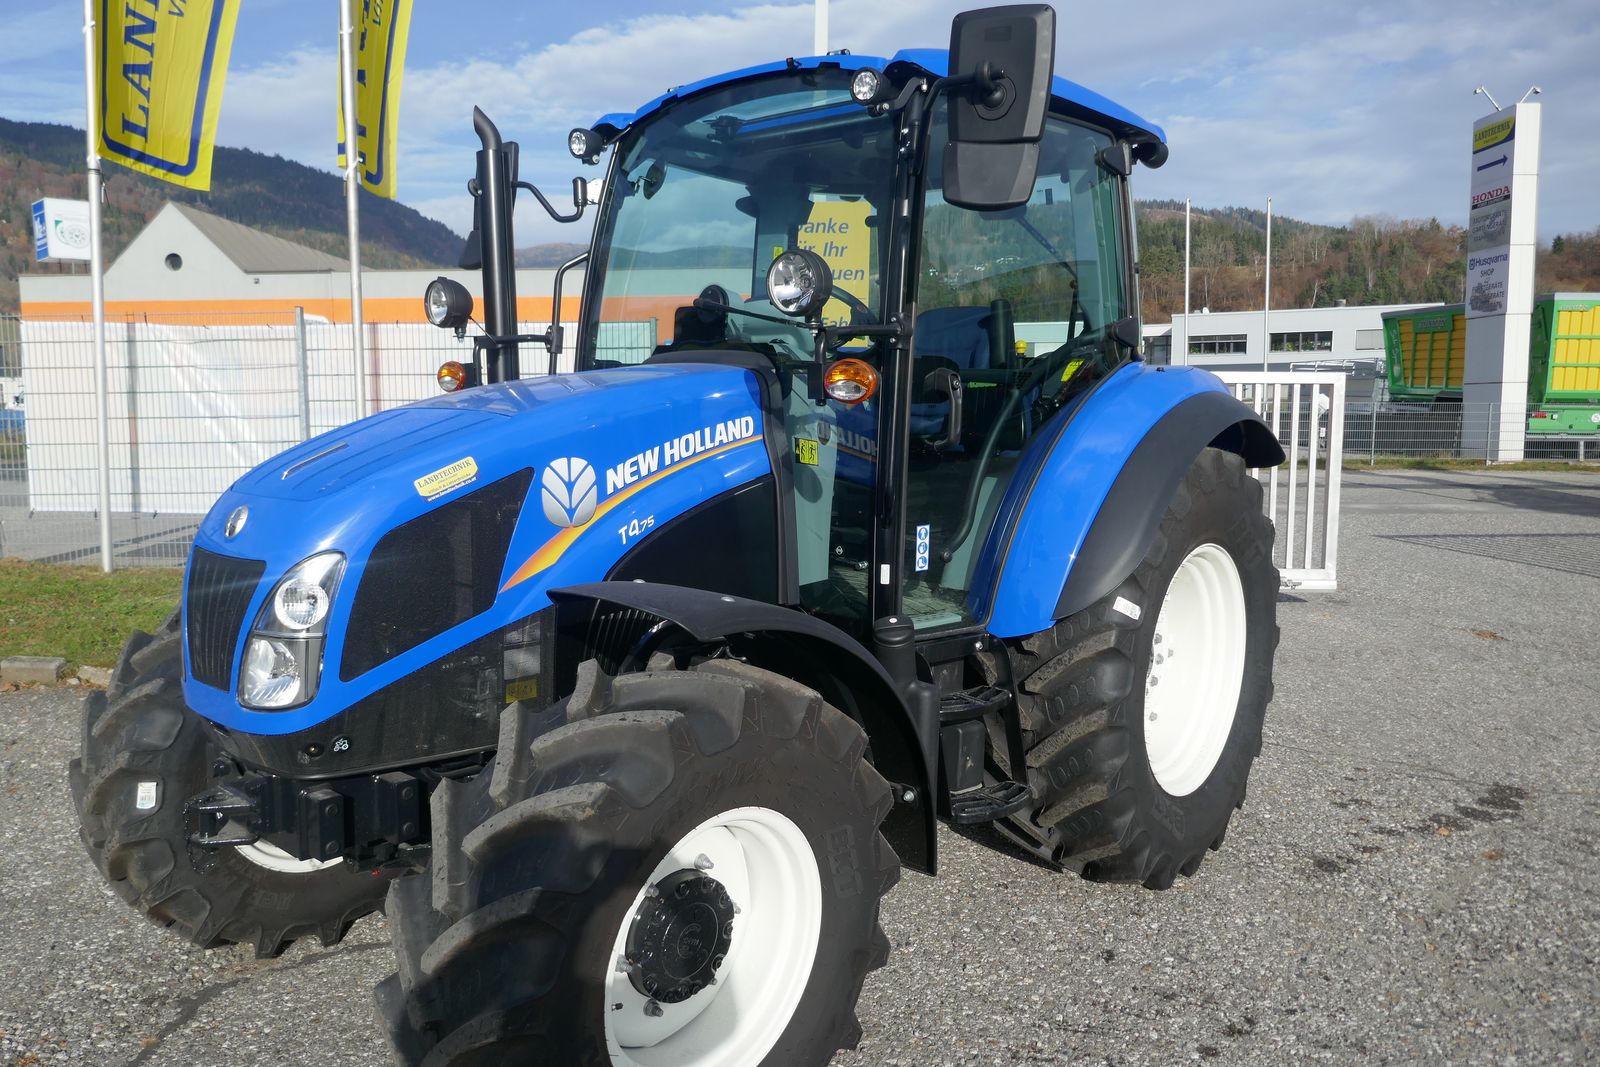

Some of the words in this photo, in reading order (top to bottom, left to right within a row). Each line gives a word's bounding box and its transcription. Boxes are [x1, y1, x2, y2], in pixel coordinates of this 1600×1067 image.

[1471, 186, 1511, 205] HONDA
[799, 218, 849, 234] anke
[823, 241, 848, 257] Ihr
[1480, 268, 1495, 278] SHOP
[606, 446, 660, 495] NEW
[663, 415, 754, 466] HOLLAND
[417, 459, 472, 488] LANDTECHNIK
